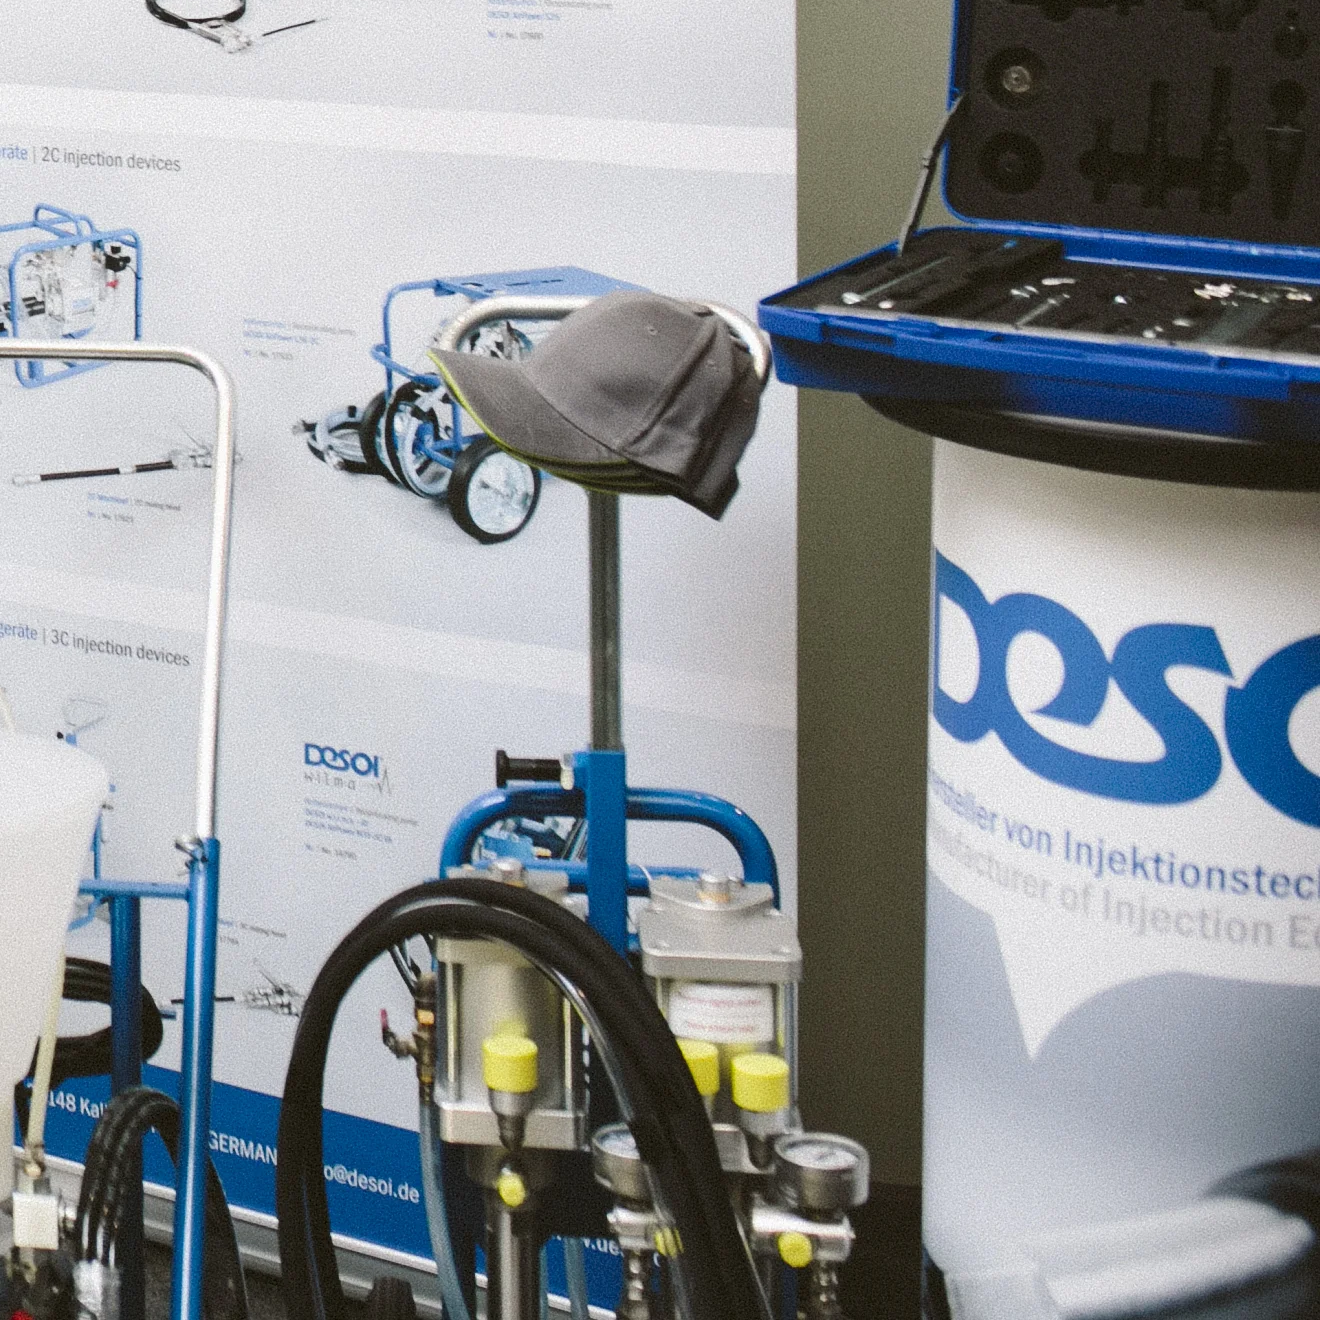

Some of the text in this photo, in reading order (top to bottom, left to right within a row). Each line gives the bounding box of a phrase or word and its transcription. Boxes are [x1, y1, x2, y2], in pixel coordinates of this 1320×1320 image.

[41, 146, 60, 163] 2C
[63, 148, 123, 168] injection
[127, 154, 181, 172] devices
[51, 629, 70, 647] 3C
[72, 633, 133, 658] injection
[136, 645, 190, 667] devices
[1004, 817, 1052, 856] von
[1060, 884, 1100, 916] of
[1103, 889, 1274, 948] Injection
[208, 1129, 278, 1166] GERMAN
